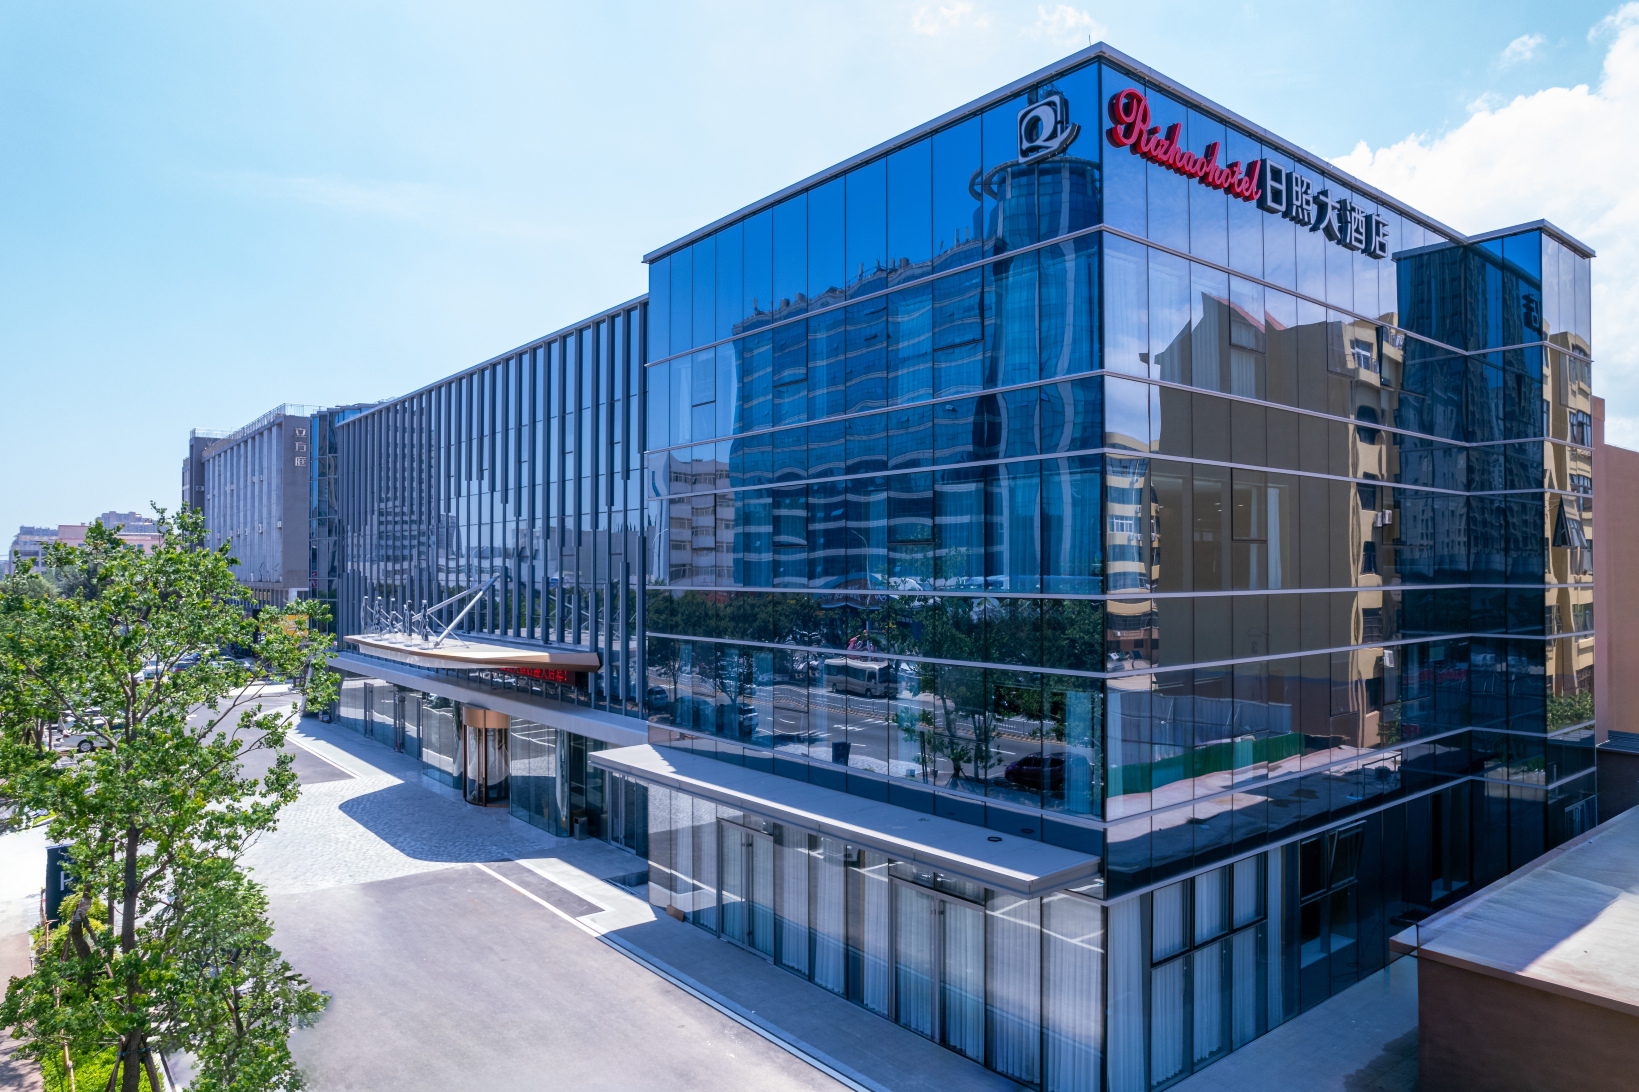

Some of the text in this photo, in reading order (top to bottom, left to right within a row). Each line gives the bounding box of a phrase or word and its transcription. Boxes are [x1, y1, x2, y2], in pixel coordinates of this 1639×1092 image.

[1258, 158, 1389, 259] 日照大酒店
